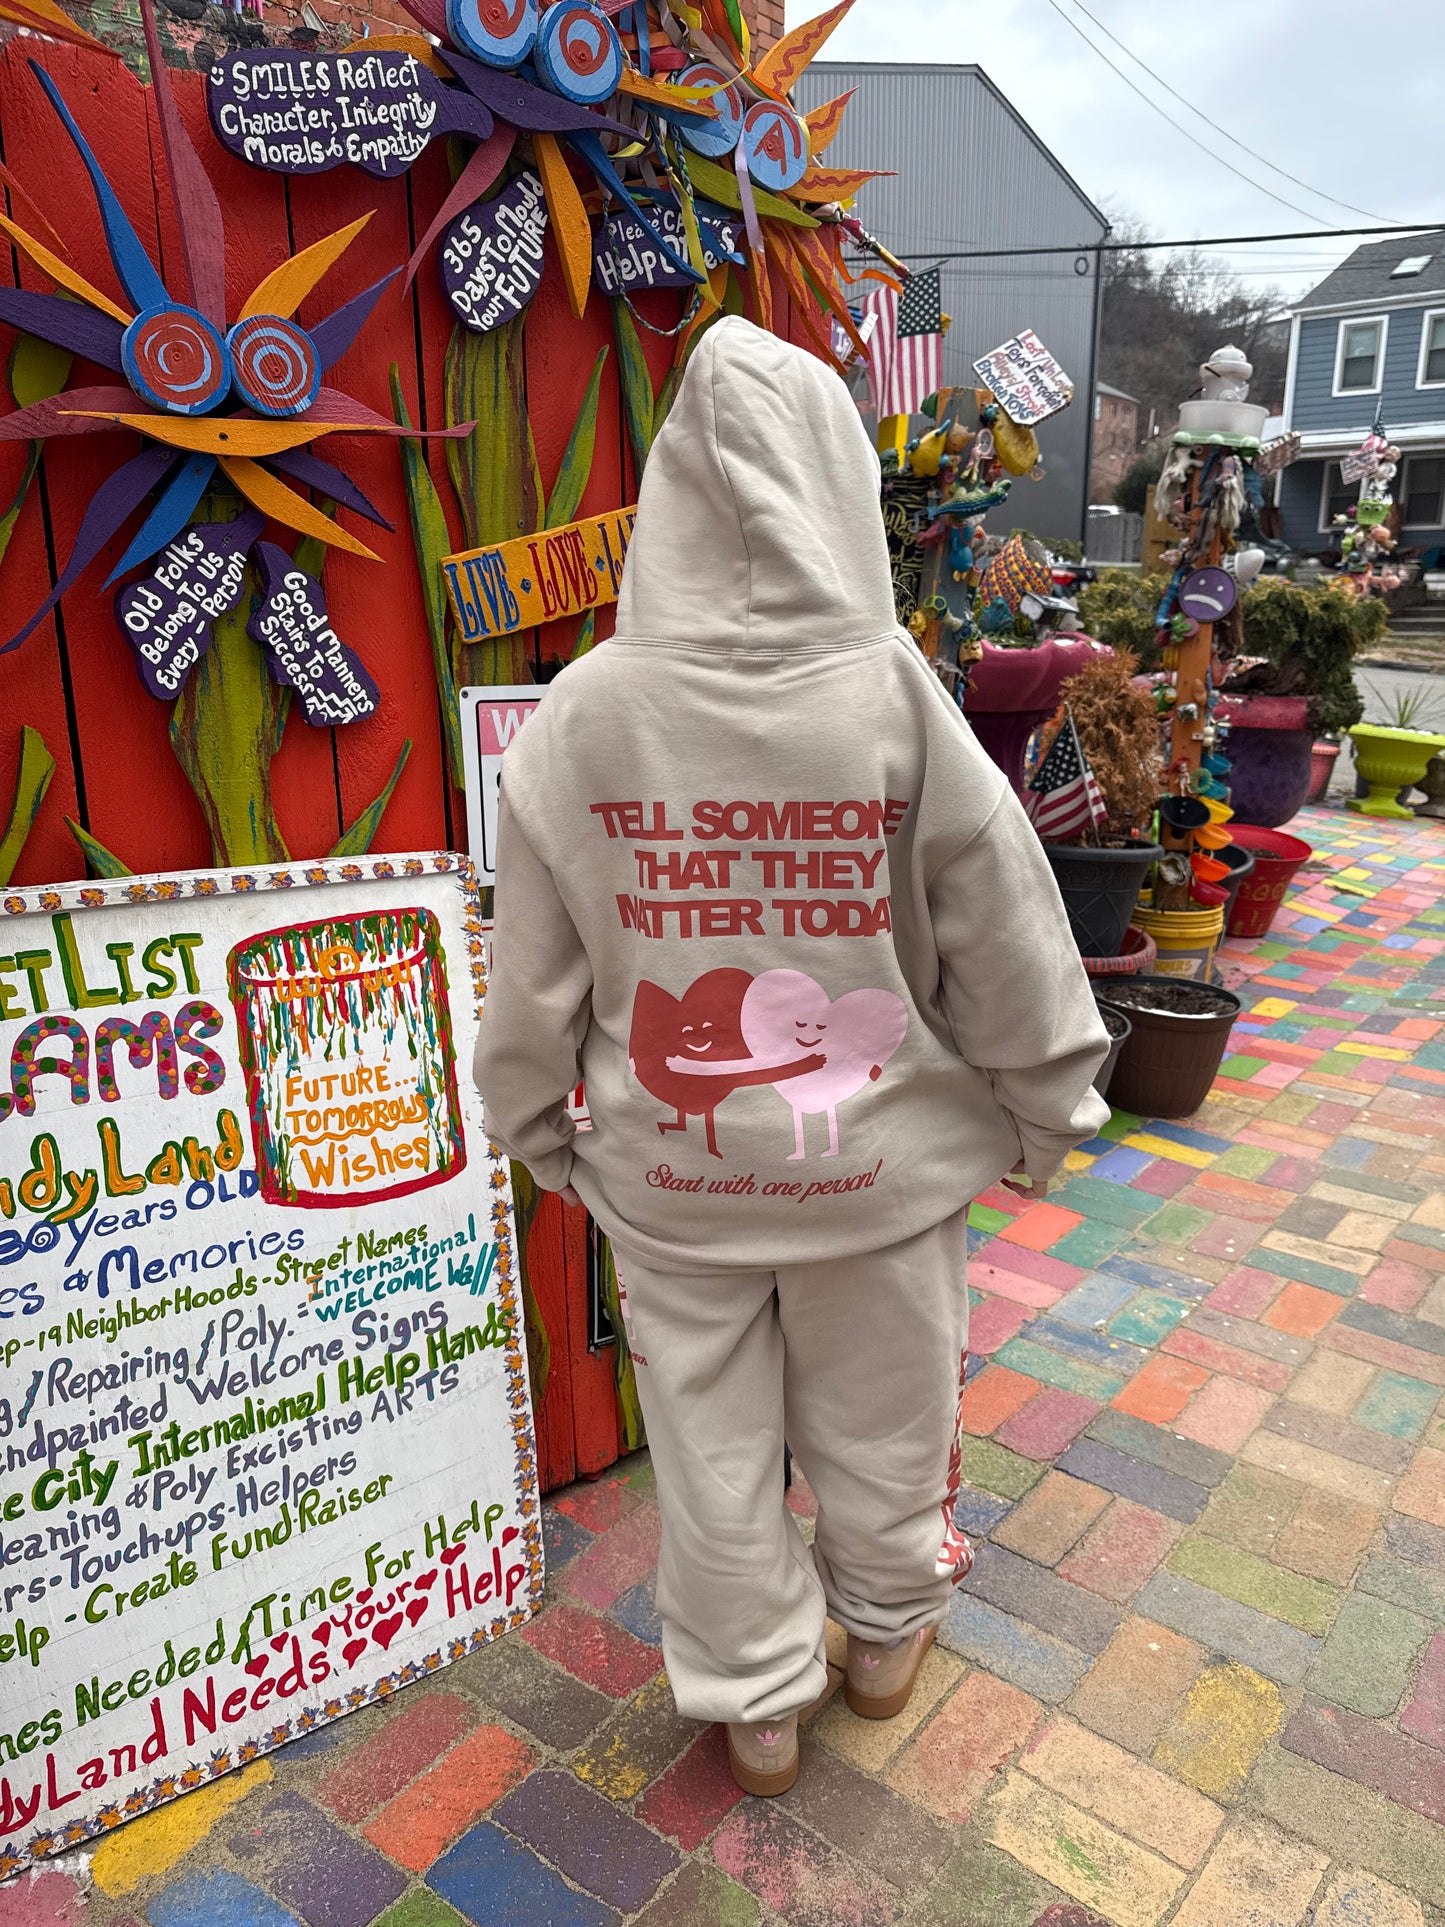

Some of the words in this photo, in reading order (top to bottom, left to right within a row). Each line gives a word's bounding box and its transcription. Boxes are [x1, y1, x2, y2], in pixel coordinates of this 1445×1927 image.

[232, 60, 331, 95] SMILES
[337, 53, 420, 91] Reflect
[220, 101, 337, 134] Character,
[336, 92, 437, 129] Integrity
[243, 136, 325, 164] Morals
[345, 131, 431, 170] Empathy
[494, 171, 544, 239] Mould
[443, 214, 482, 274] 365
[467, 294, 505, 332] Your
[494, 205, 548, 310] FUTURE
[479, 236, 512, 263] To
[596, 243, 657, 291] Help
[451, 256, 496, 313] Days
[124, 586, 163, 632] Old
[154, 532, 204, 590] Folks
[140, 601, 197, 664] Belong
[176, 581, 207, 602] To
[196, 552, 224, 580] Us
[445, 549, 520, 640] LIVE
[527, 527, 599, 618] LOVE
[260, 615, 315, 695] Success
[270, 592, 310, 653] Stairs
[305, 649, 325, 679] To
[284, 571, 328, 631] Good
[316, 629, 375, 713] Manners
[589, 801, 685, 841] TELL
[691, 798, 910, 841] SOMEONE
[634, 849, 741, 891] THAT
[751, 848, 886, 889] THEY
[771, 895, 893, 938] TODA
[0, 1000, 226, 1123] AMS
[285, 1092, 429, 1135] TOMORROWS
[185, 1169, 261, 1211] OLD
[300, 1136, 431, 1189] Wishes
[645, 1163, 706, 1194] Start
[706, 1172, 759, 1196] with
[761, 1180, 804, 1197] one
[796, 1157, 884, 1204] person!
[97, 1228, 305, 1299] Memories
[306, 1212, 477, 1303] International
[357, 1224, 428, 1262] Names
[315, 1257, 442, 1323] WELCOME
[448, 1241, 499, 1297] Wall
[0, 1381, 168, 1476] ndpainted
[185, 1338, 345, 1405] Welcome
[352, 1300, 449, 1355] Signs
[47, 1346, 190, 1409] Repairing
[219, 1303, 295, 1363] Poly.
[31, 1448, 120, 1512] City
[338, 1351, 421, 1404] Help
[426, 1301, 512, 1371] Hands
[152, 1463, 218, 1512] Poly
[226, 1409, 363, 1480] Excisting
[371, 1362, 460, 1424] ARTS
[75, 1617, 226, 1727] Needed
[251, 1576, 354, 1638] Time
[365, 1541, 415, 1587] For
[424, 1500, 504, 1560] Help
[182, 1635, 331, 1746] Needs
[330, 1580, 412, 1638] Your
[445, 1546, 526, 1618] Help
